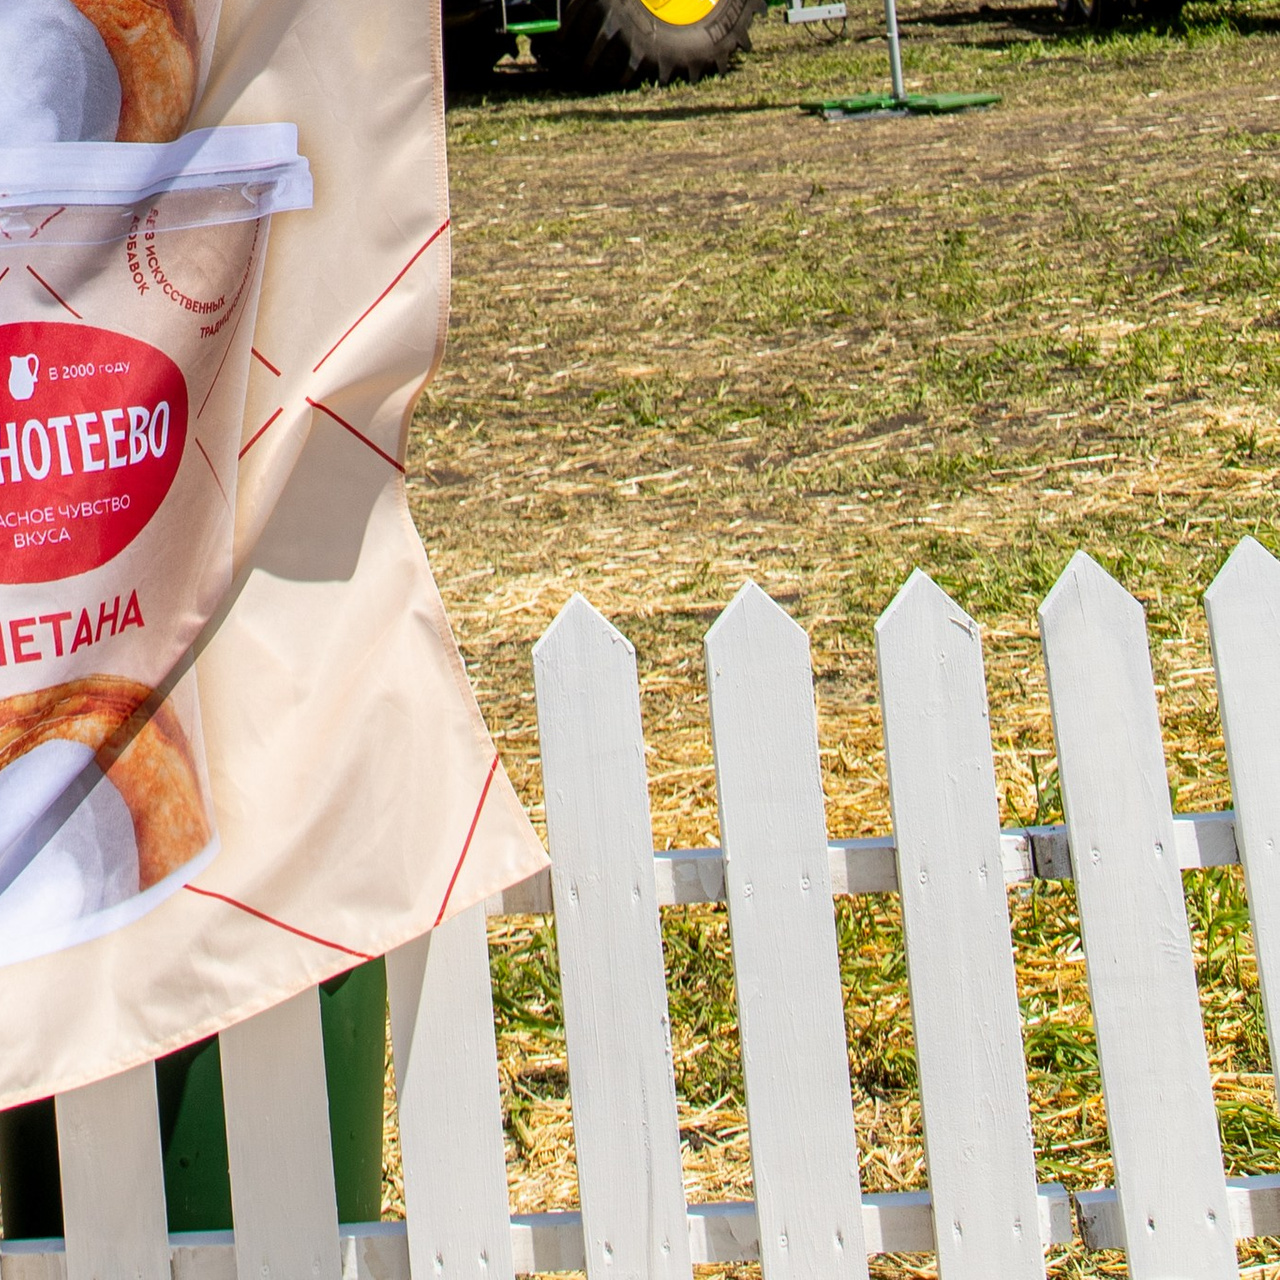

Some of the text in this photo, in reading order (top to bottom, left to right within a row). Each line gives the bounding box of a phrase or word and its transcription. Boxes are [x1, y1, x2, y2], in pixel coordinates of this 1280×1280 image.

[145, 245, 226, 315] ИСКУССТВЕННЫХ
[48, 367, 59, 381] В
[62, 363, 95, 380] 2000
[58, 494, 131, 518] ЧУВСТВО
[13, 527, 71, 549] ВКУСА
